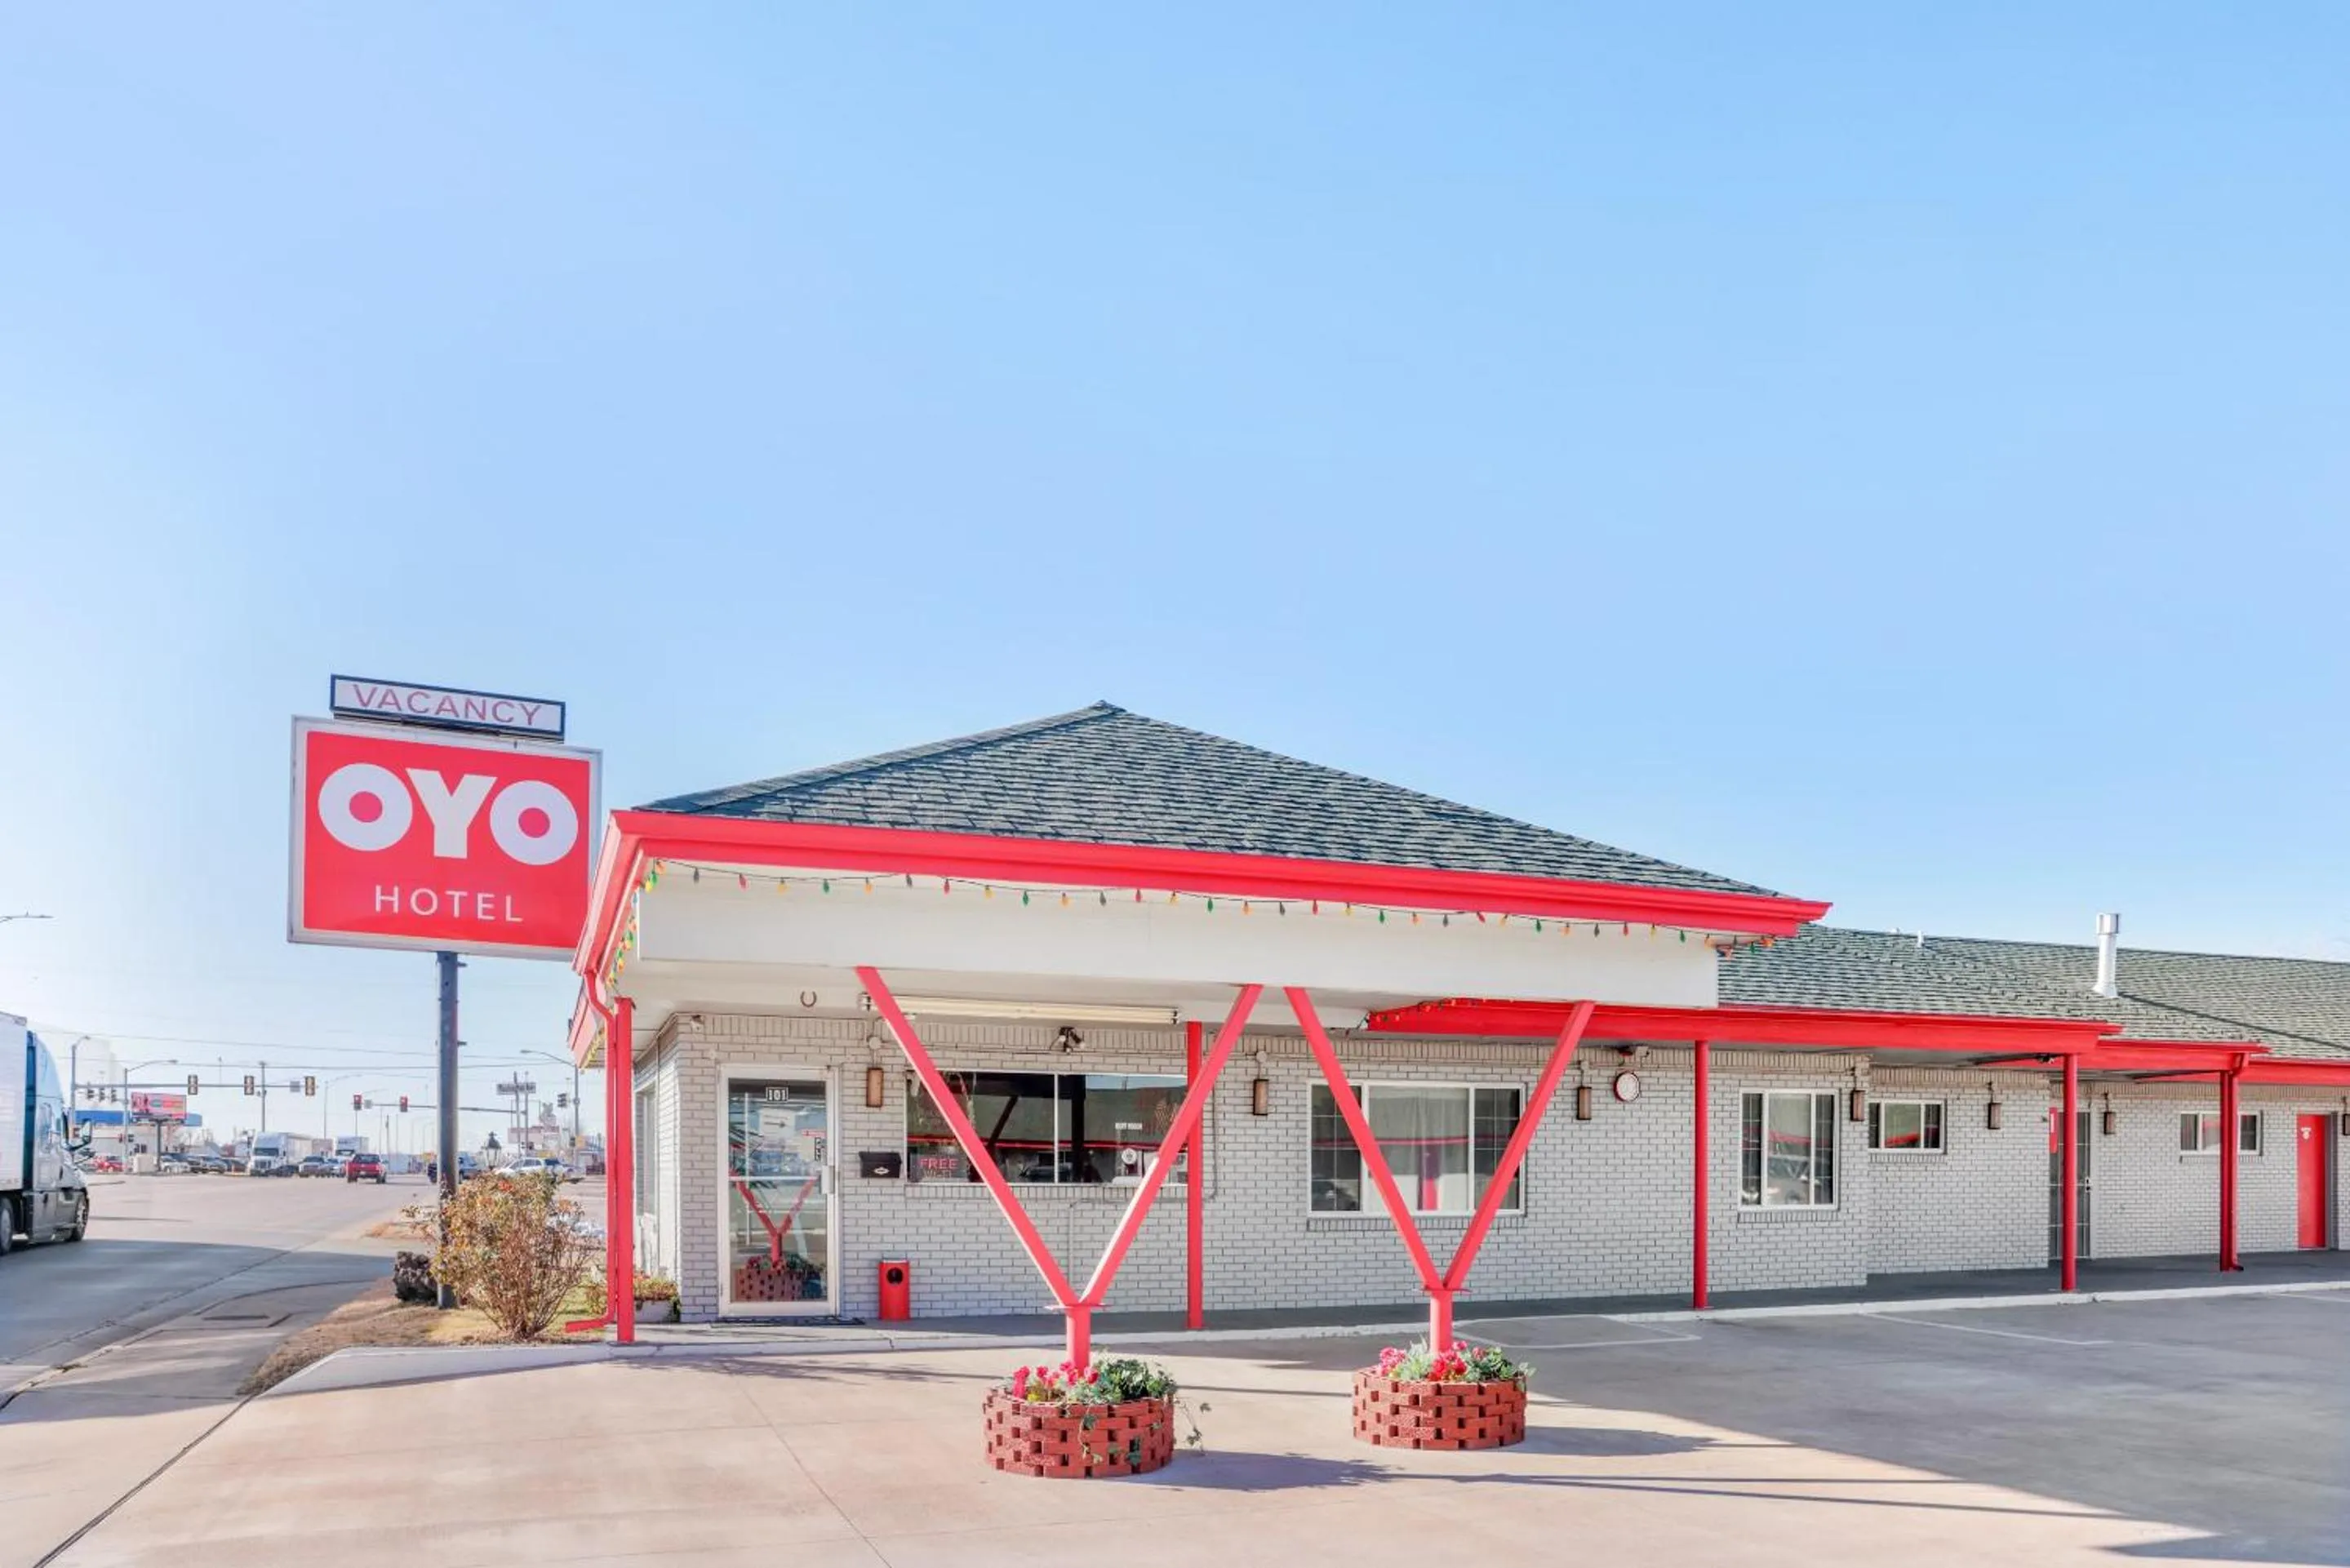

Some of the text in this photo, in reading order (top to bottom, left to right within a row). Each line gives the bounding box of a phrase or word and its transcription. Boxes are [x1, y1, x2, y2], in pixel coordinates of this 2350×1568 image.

[353, 683, 542, 726] VACANCY
[318, 762, 579, 866] OYO
[375, 885, 523, 922] HOTEL
[768, 1090, 786, 1101] 101
[920, 1157, 958, 1170] FREE
